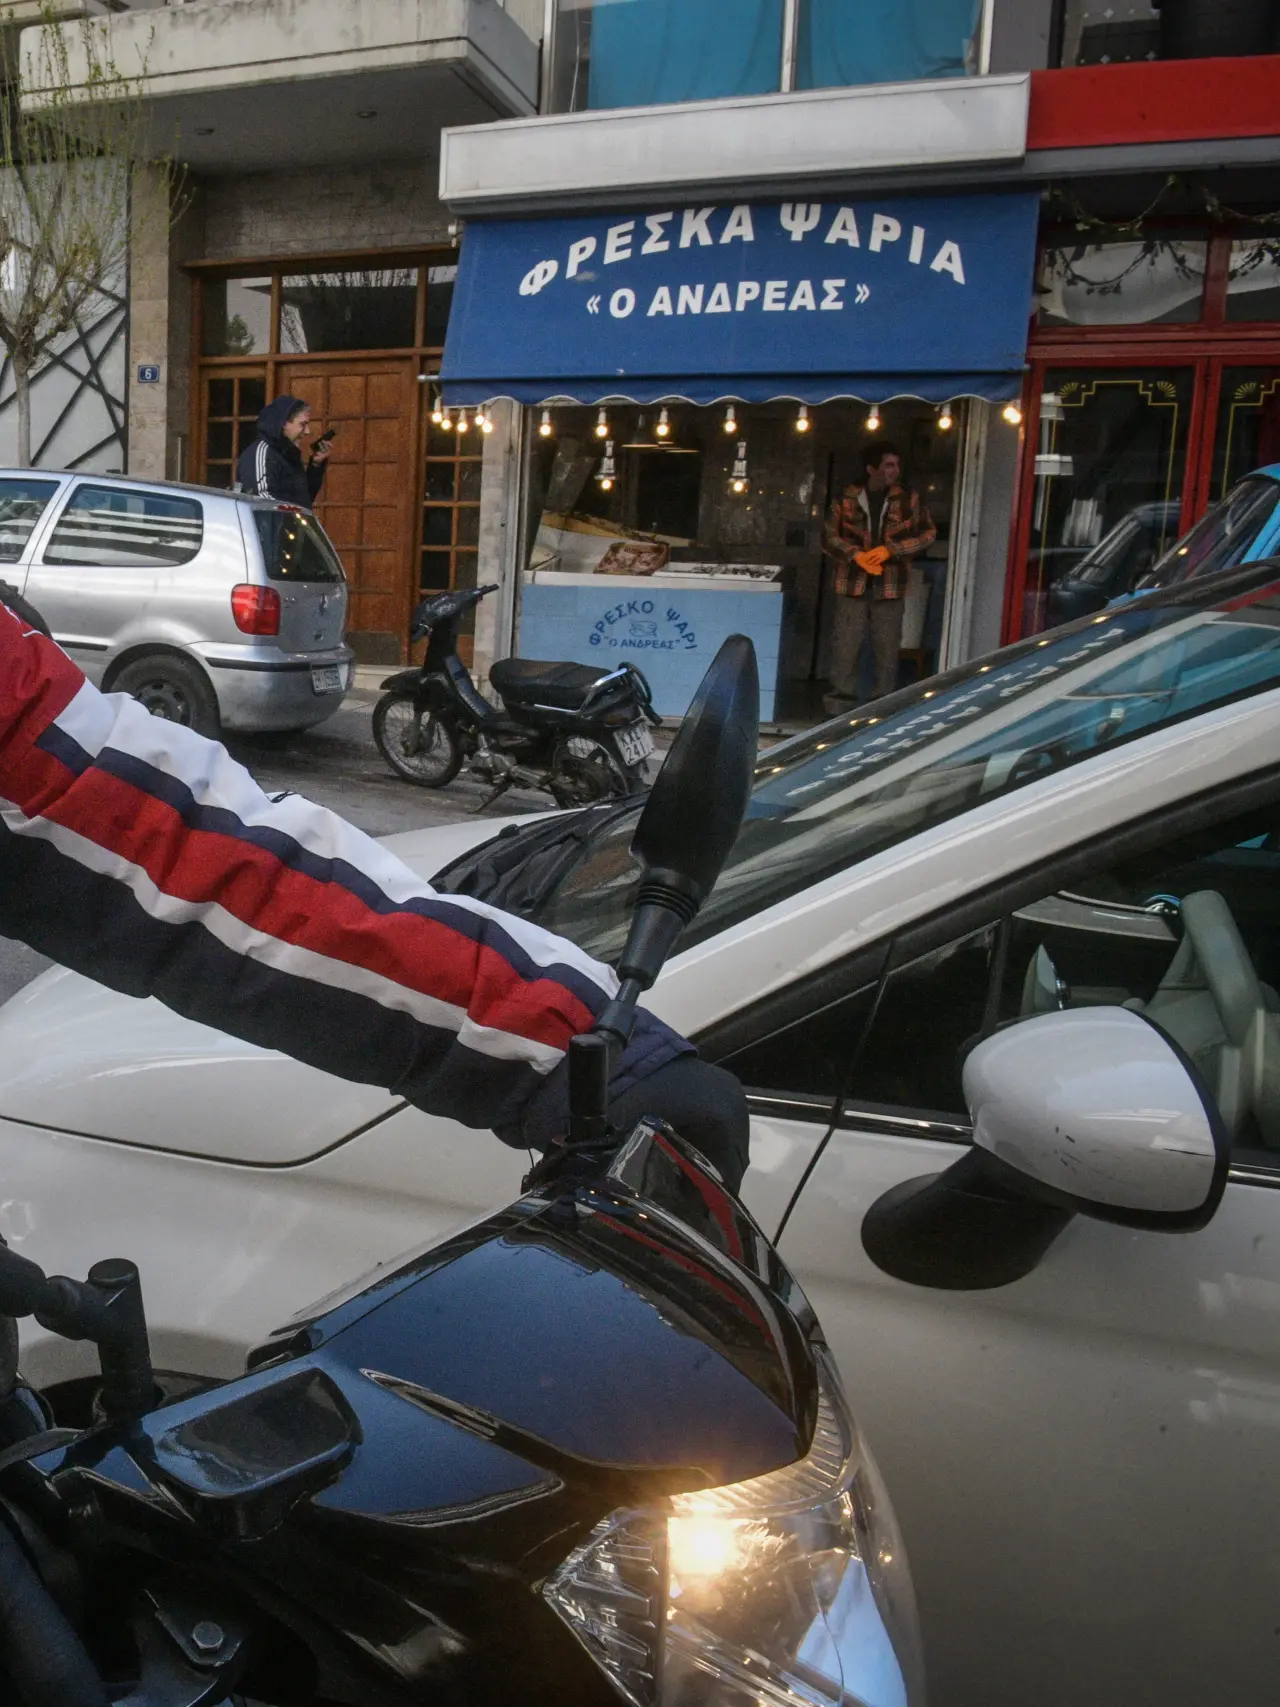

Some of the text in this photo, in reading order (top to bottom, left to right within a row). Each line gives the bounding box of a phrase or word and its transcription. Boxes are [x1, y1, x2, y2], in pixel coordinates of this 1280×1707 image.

[519, 202, 966, 296] ΦΡΕΣΚΑ ΨΑΡΙΑ
[145, 368, 152, 380] 6
